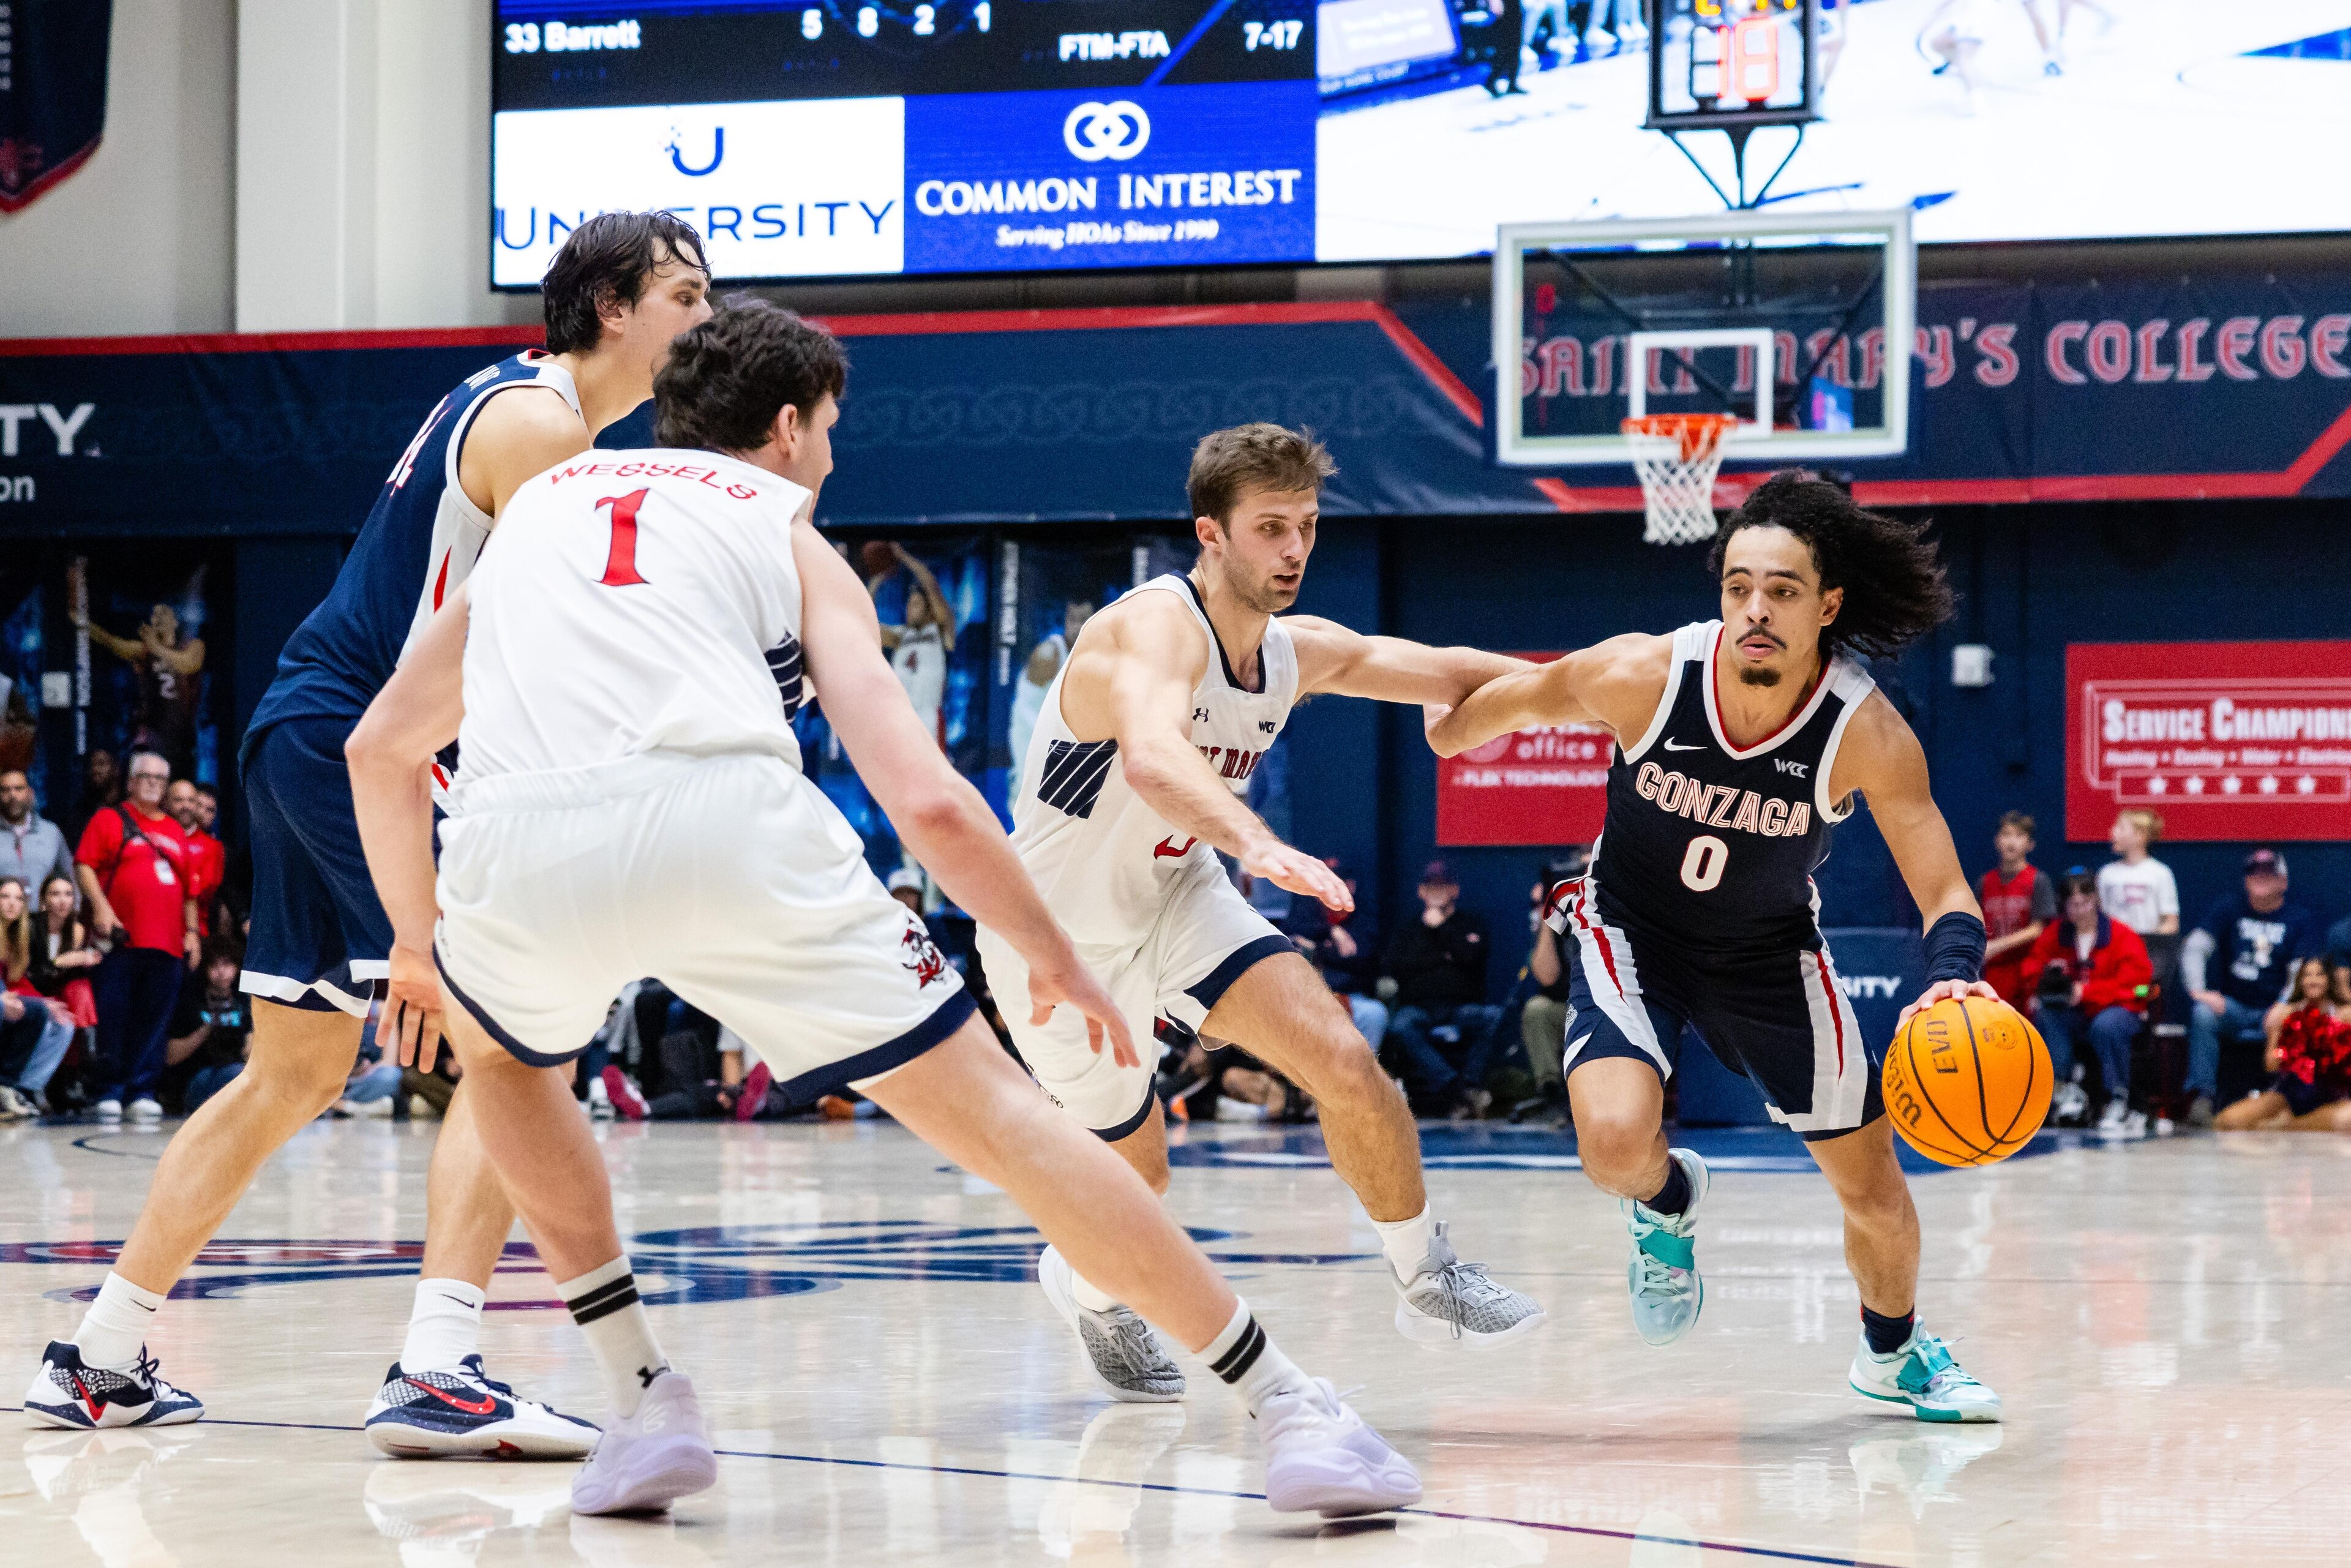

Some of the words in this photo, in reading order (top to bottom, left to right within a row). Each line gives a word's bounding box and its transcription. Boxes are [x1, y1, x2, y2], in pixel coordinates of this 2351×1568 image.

[504, 23, 540, 53] 33
[544, 19, 641, 52] Barrett
[801, 9, 823, 40] 5
[857, 6, 879, 38] 8
[912, 5, 936, 36] 2
[973, 1, 991, 32] 1
[1058, 31, 1172, 62] FTM-FTA
[1243, 20, 1303, 51] 7-17
[916, 177, 1097, 216] COMMON
[1119, 170, 1302, 209] INTEREST
[500, 200, 896, 250] UNRSITY
[996, 224, 1065, 250] Serving
[1122, 219, 1172, 242] Since
[2045, 314, 2351, 384] COLLEGE
[551, 462, 758, 500] WESSELS
[592, 486, 652, 587] 1
[1517, 736, 1597, 760] office
[1774, 758, 1810, 779] WCC
[1635, 761, 1811, 837] GONZAGA
[1680, 835, 1729, 892] 0
